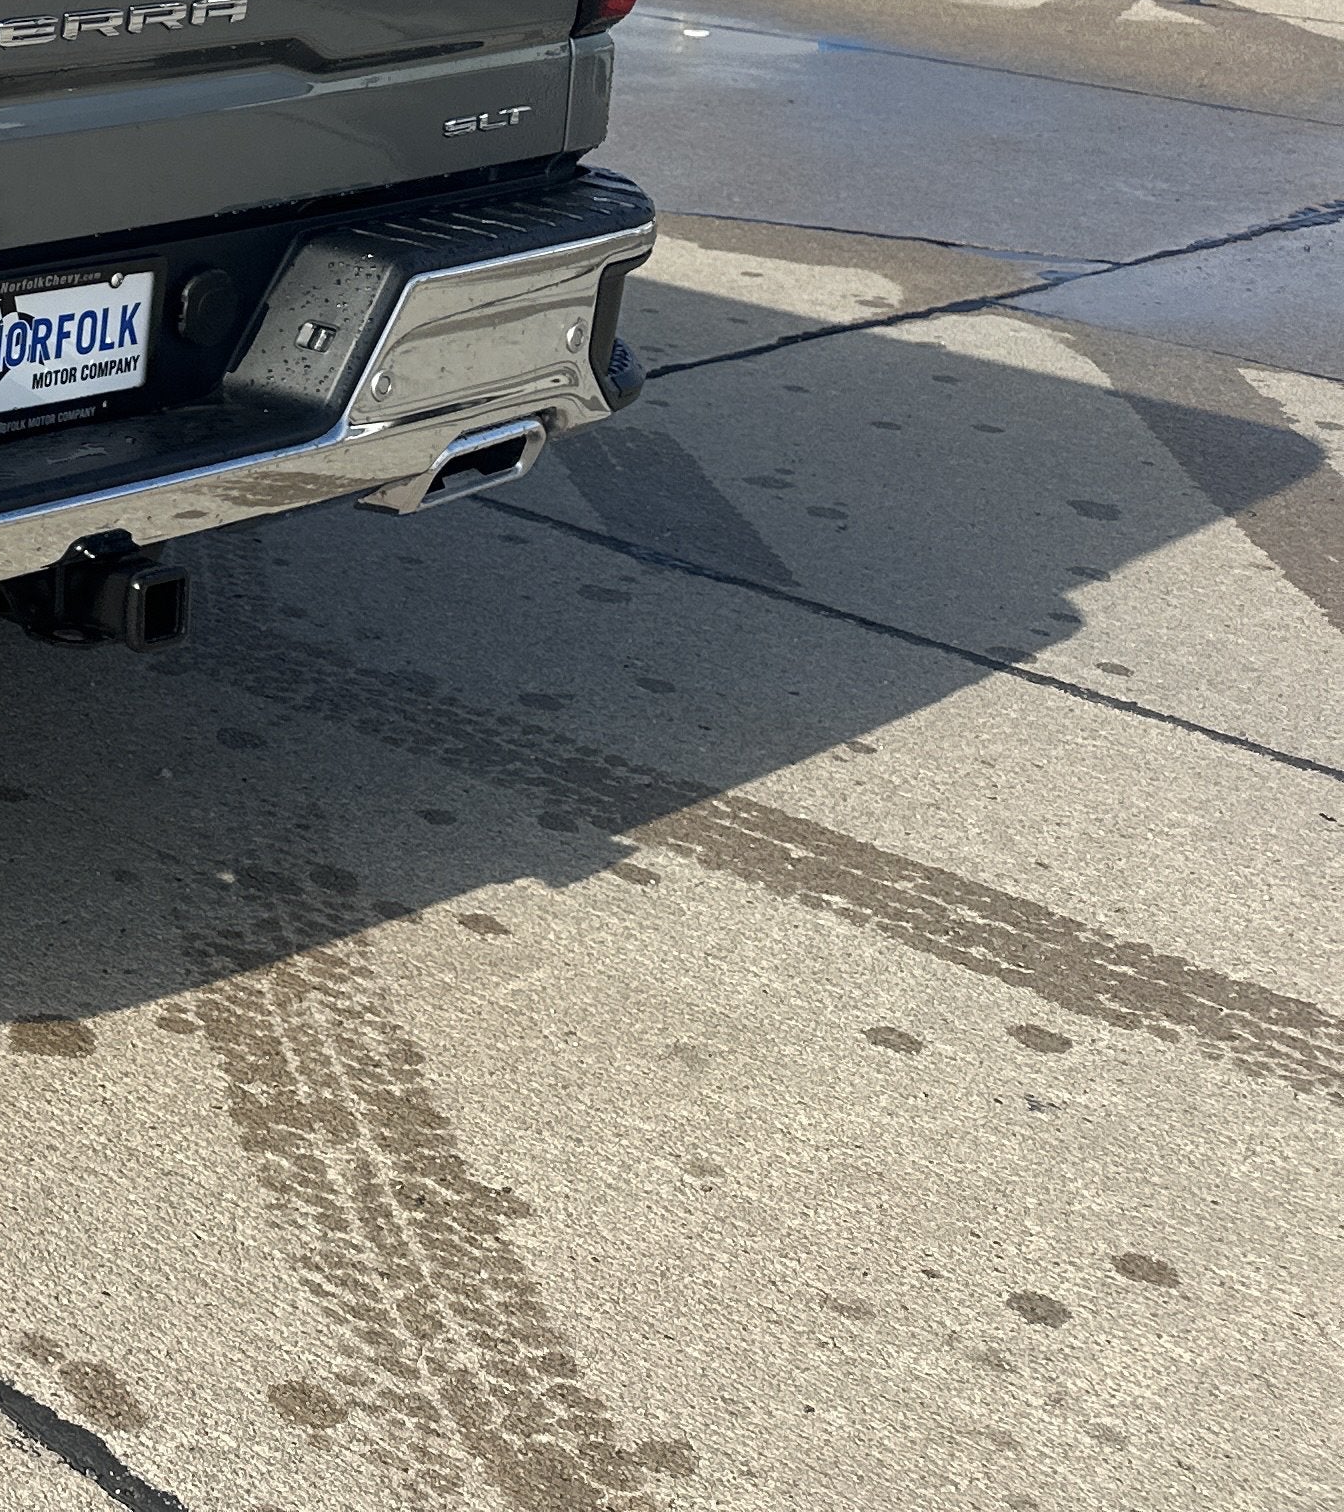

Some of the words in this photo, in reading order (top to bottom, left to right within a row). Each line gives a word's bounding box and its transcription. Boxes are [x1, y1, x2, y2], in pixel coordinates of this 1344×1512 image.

[443, 106, 532, 137] SLT
[0, 272, 102, 294] NorfolkChevy.com
[31, 366, 77, 390] MOTOR
[80, 354, 141, 381] COMPANY
[28, 413, 56, 428] MOTOR
[58, 406, 96, 423] COMPANY
